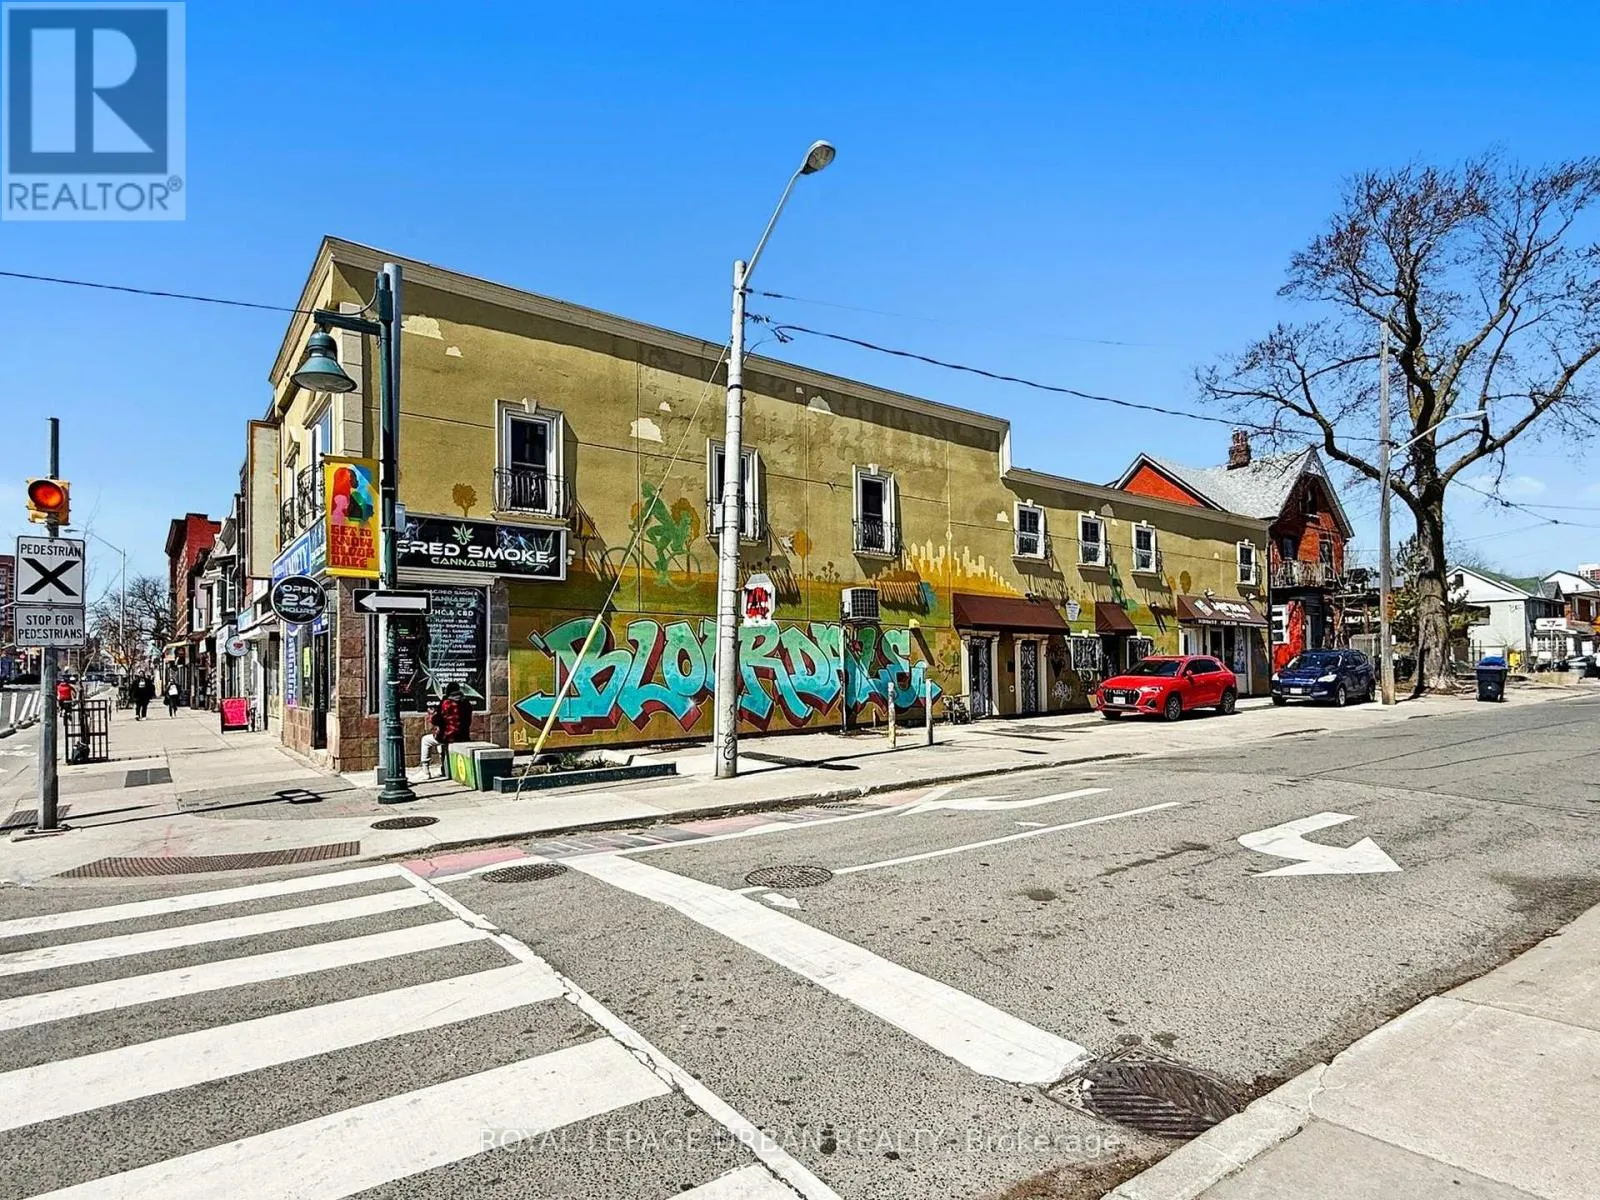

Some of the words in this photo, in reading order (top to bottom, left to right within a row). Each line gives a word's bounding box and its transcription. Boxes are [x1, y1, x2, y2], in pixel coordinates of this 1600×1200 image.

[330, 535, 374, 547] KNOW
[20, 543, 81, 557] PEDESTRIAN
[330, 546, 376, 559] BLOOR
[467, 545, 552, 564] SMOKE
[430, 556, 498, 569] CANNABIS
[281, 584, 318, 594] OPEN
[281, 593, 316, 608] 24
[281, 607, 317, 615] HOURS
[25, 614, 52, 626] STOP
[55, 614, 75, 626] FOR
[18, 627, 83, 640] PEDESTRIANS
[514, 616, 942, 736] BLORDALE
